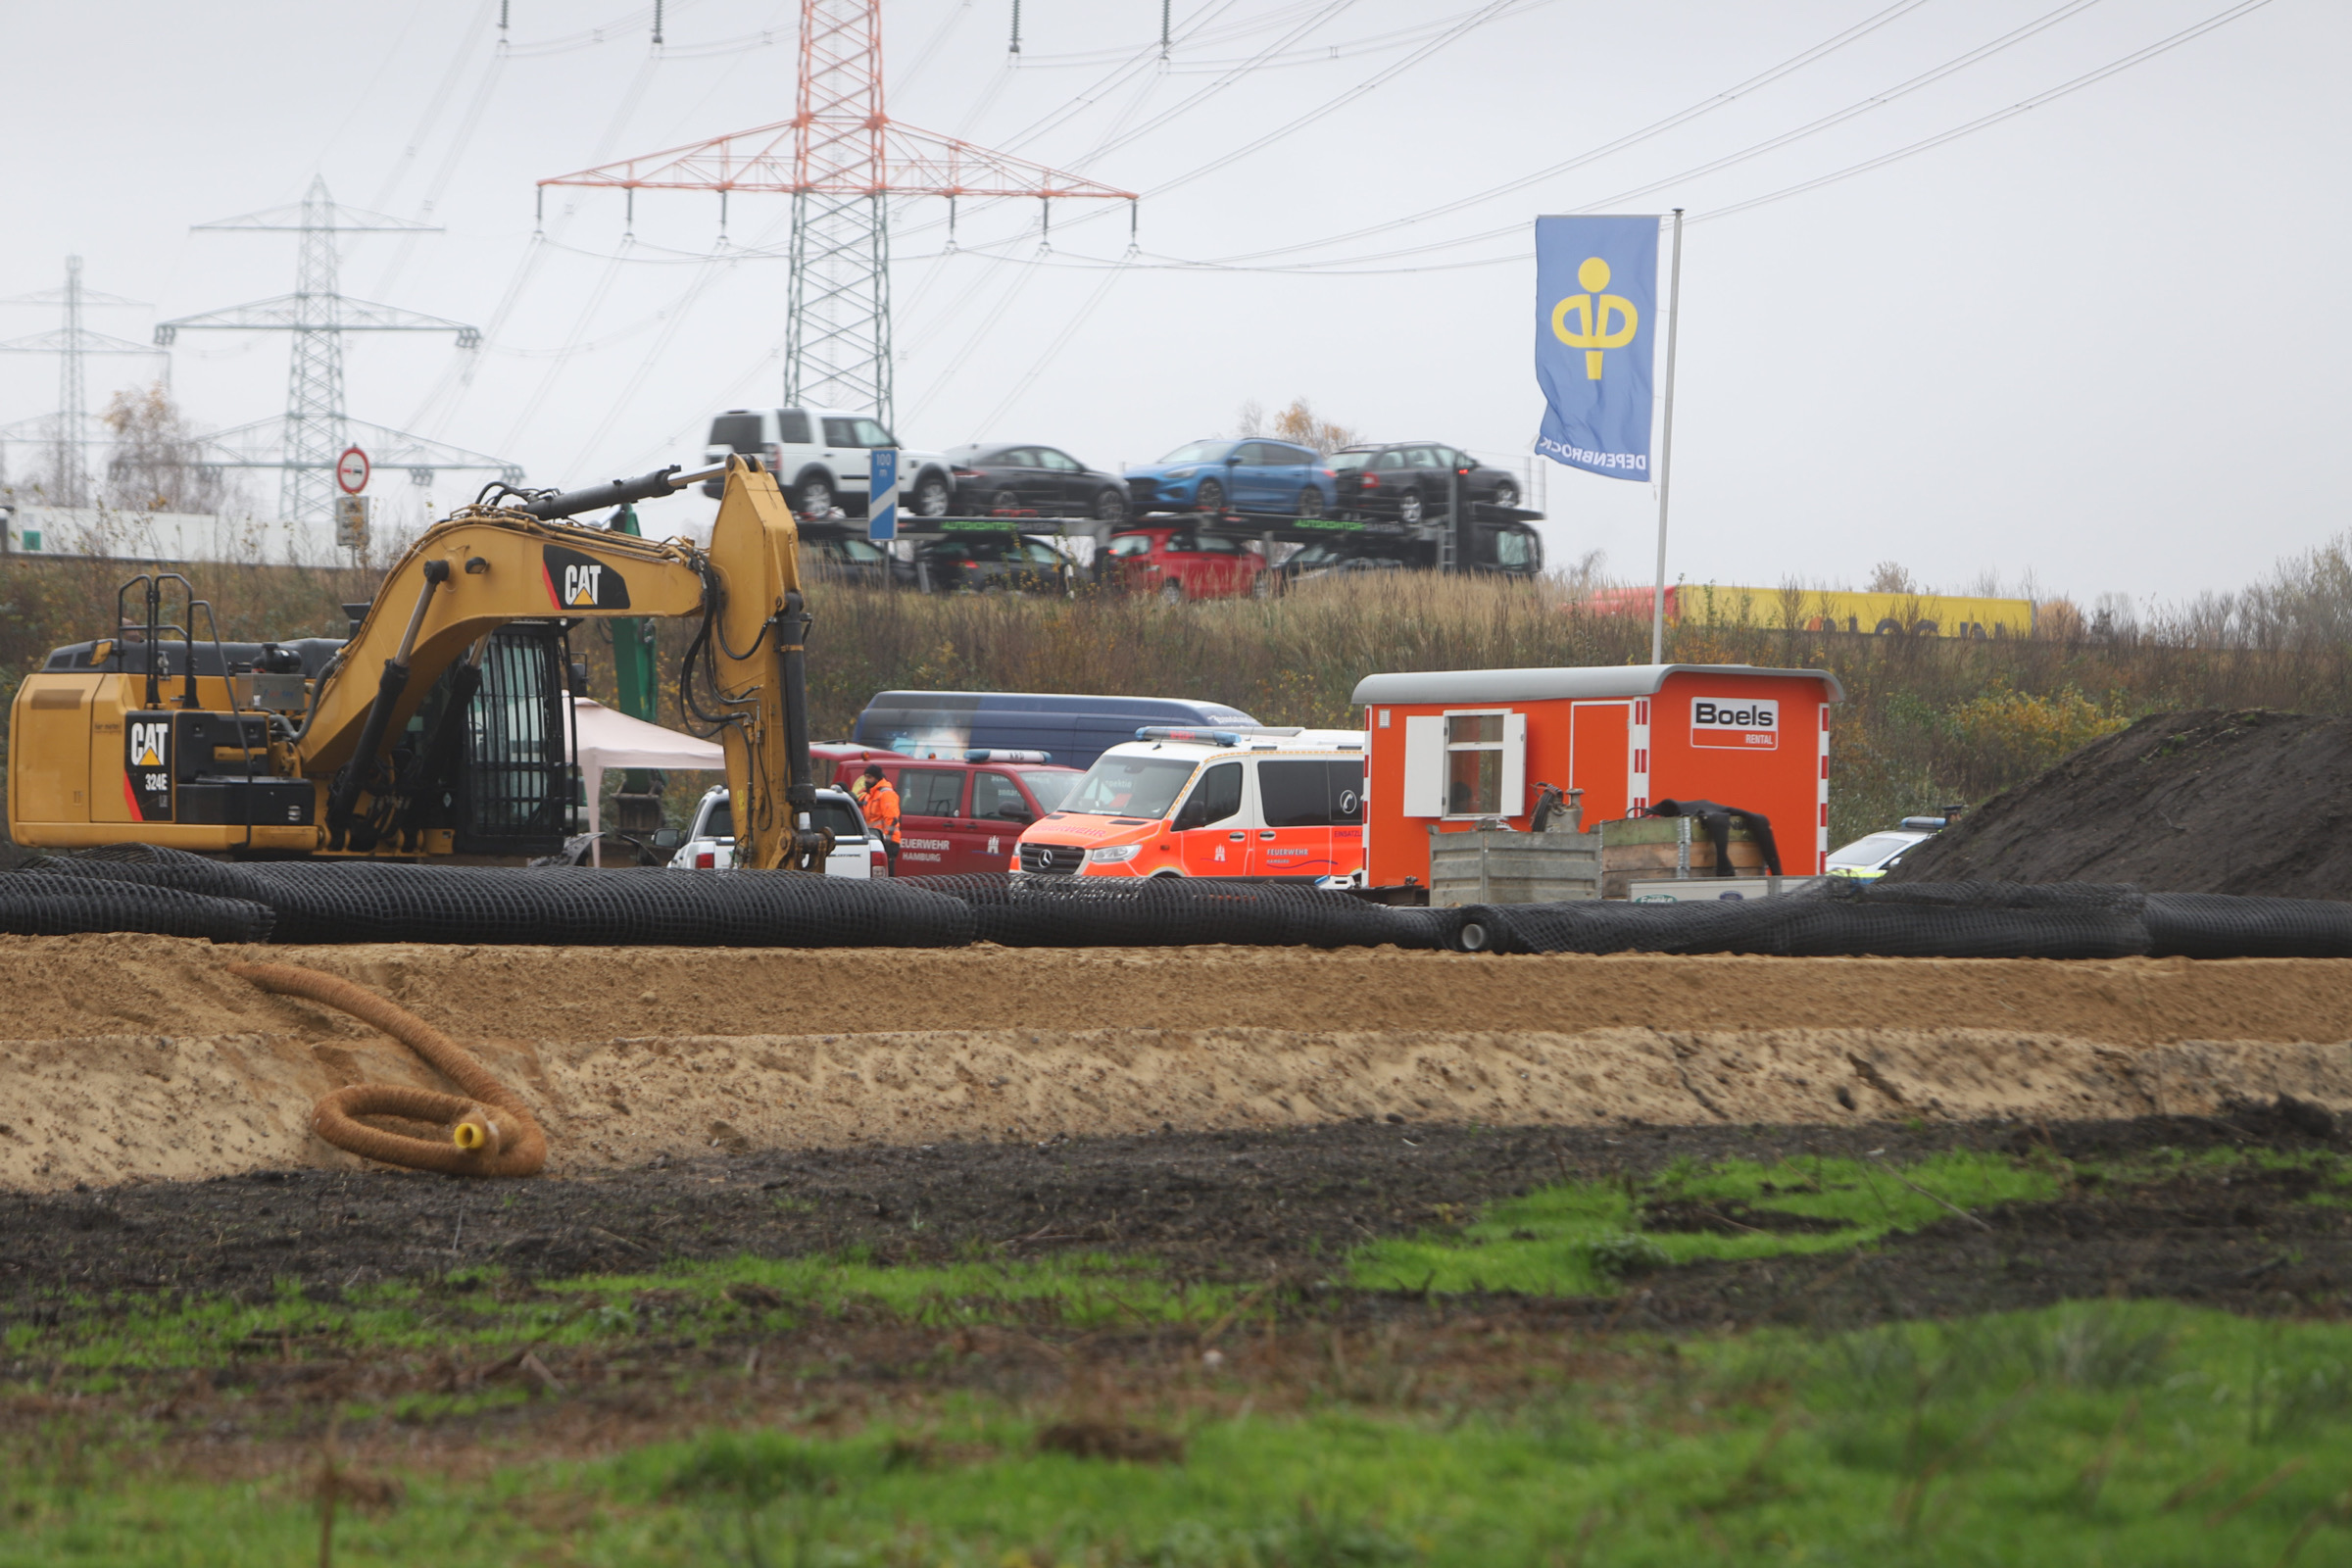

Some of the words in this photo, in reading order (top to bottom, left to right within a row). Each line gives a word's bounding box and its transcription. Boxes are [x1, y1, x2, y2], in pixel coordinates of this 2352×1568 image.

[876, 454, 892, 466] 100
[564, 564, 602, 605] CAT
[1695, 703, 1774, 726] Boels
[131, 722, 169, 765] CAT
[1745, 734, 1774, 745] RENTAL
[145, 773, 168, 791] 324E
[900, 838, 951, 851] EUERWEHR
[902, 852, 941, 862] HAMBURG
